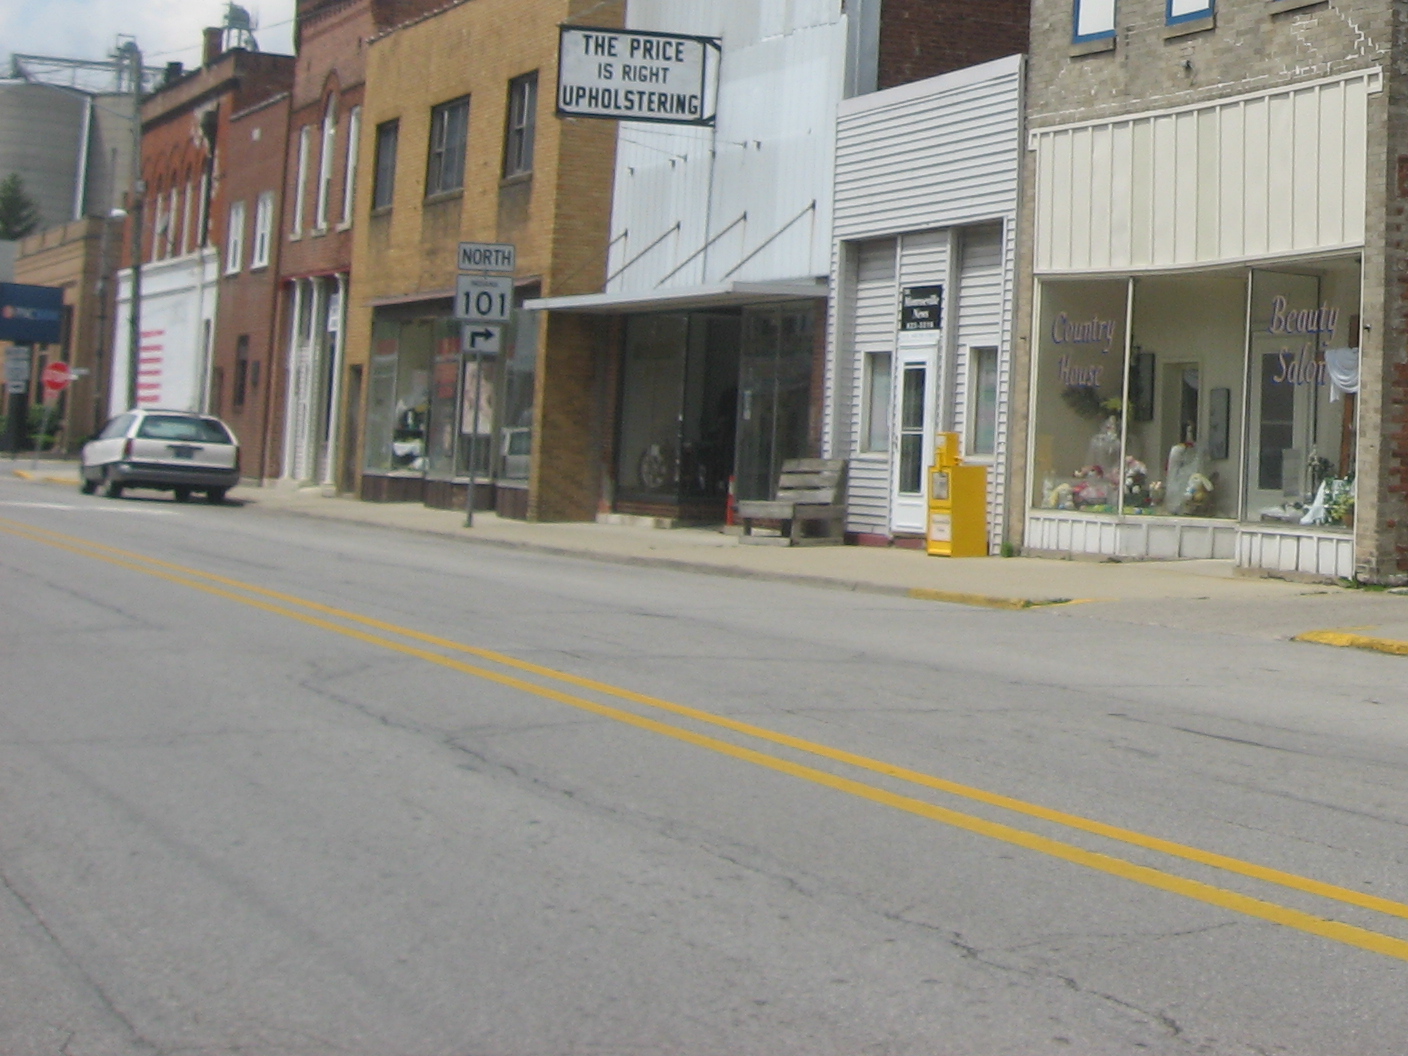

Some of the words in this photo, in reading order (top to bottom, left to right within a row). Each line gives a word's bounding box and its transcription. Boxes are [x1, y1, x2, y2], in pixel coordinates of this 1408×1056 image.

[582, 34, 619, 58] THE
[630, 38, 686, 63] PRICE
[598, 62, 613, 80] IS
[622, 65, 670, 84] RIGHT
[562, 85, 699, 116] UPHOLSTERING
[462, 249, 512, 266] NORTH
[464, 291, 506, 317] 101
[1052, 311, 1116, 354] Country
[1267, 294, 1340, 347] Beauty
[1059, 355, 1104, 388] House
